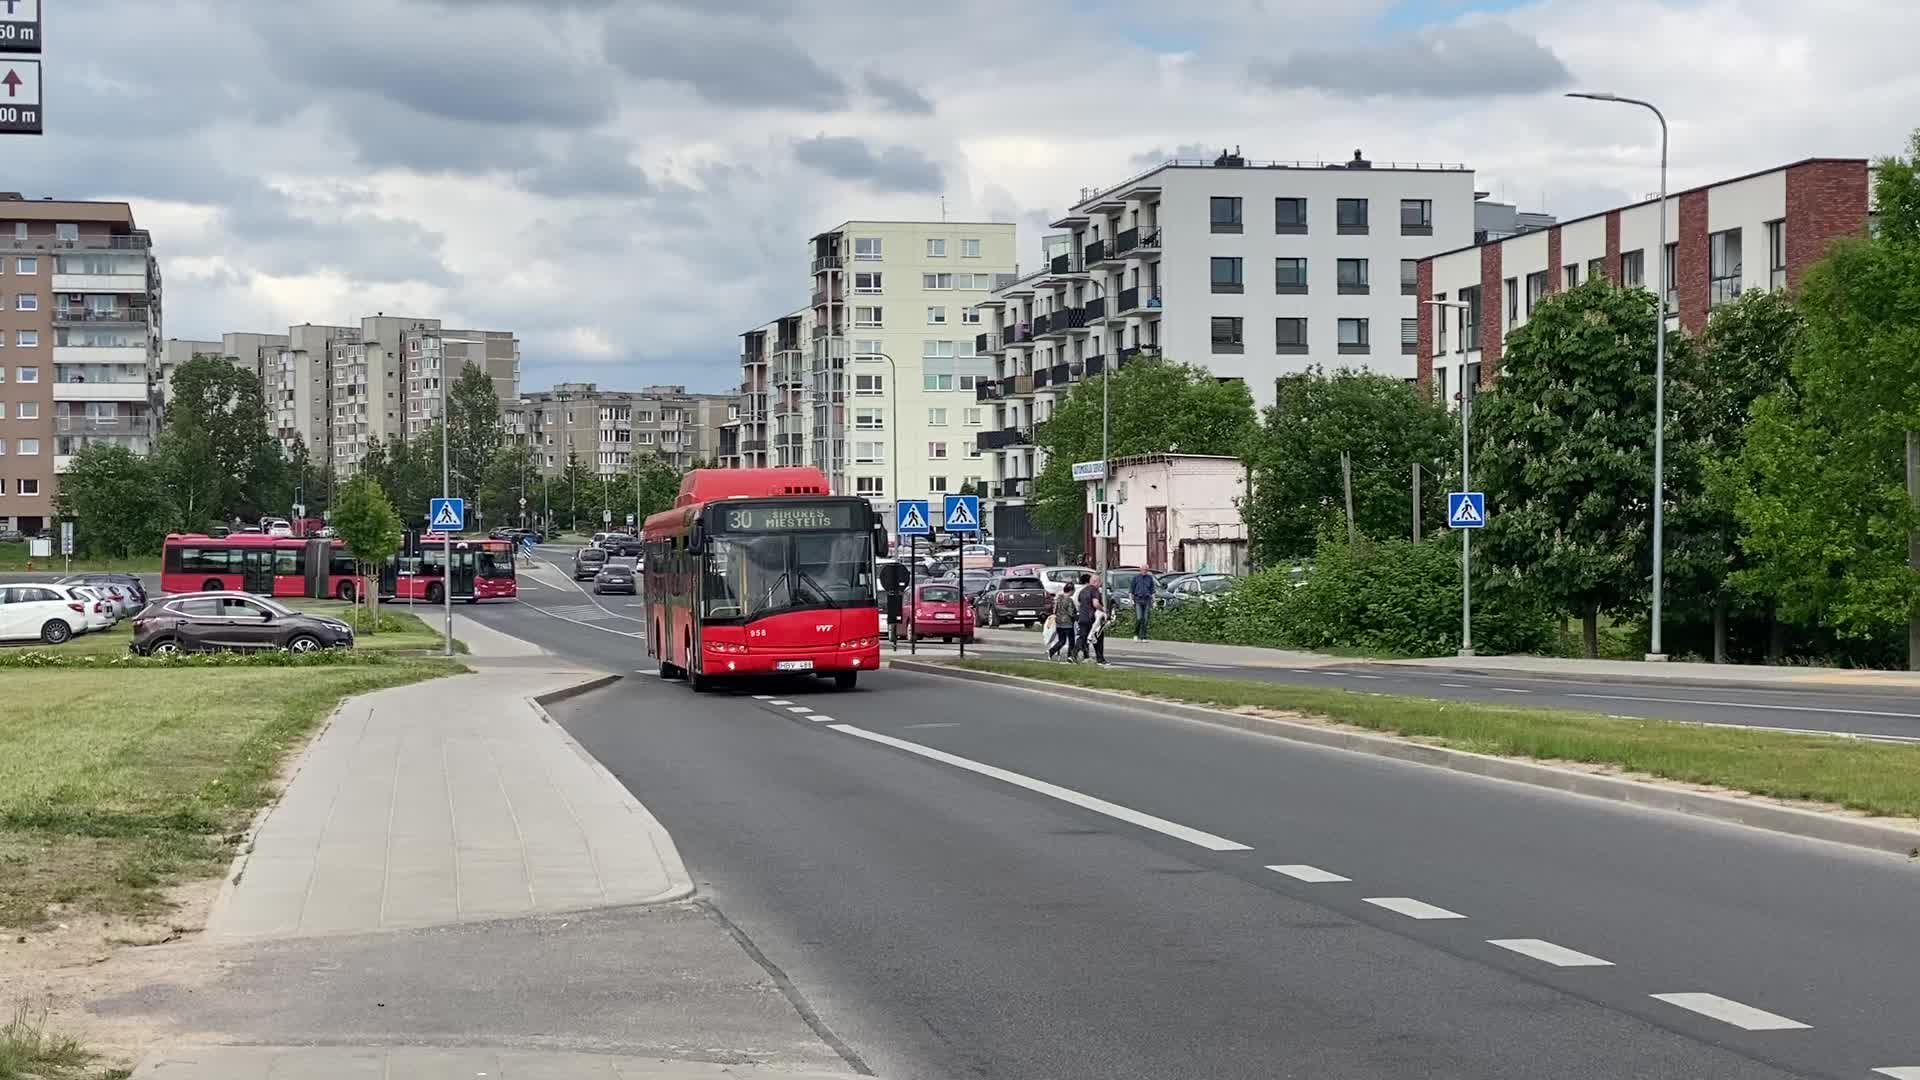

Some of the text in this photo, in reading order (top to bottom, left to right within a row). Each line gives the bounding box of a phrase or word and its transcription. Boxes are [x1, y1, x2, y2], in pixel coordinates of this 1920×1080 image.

[20, 28, 34, 40] m
[22, 110, 36, 123] m
[730, 511, 752, 529] 30
[765, 517, 831, 528] MIESTELIS
[750, 629, 767, 637] 958
